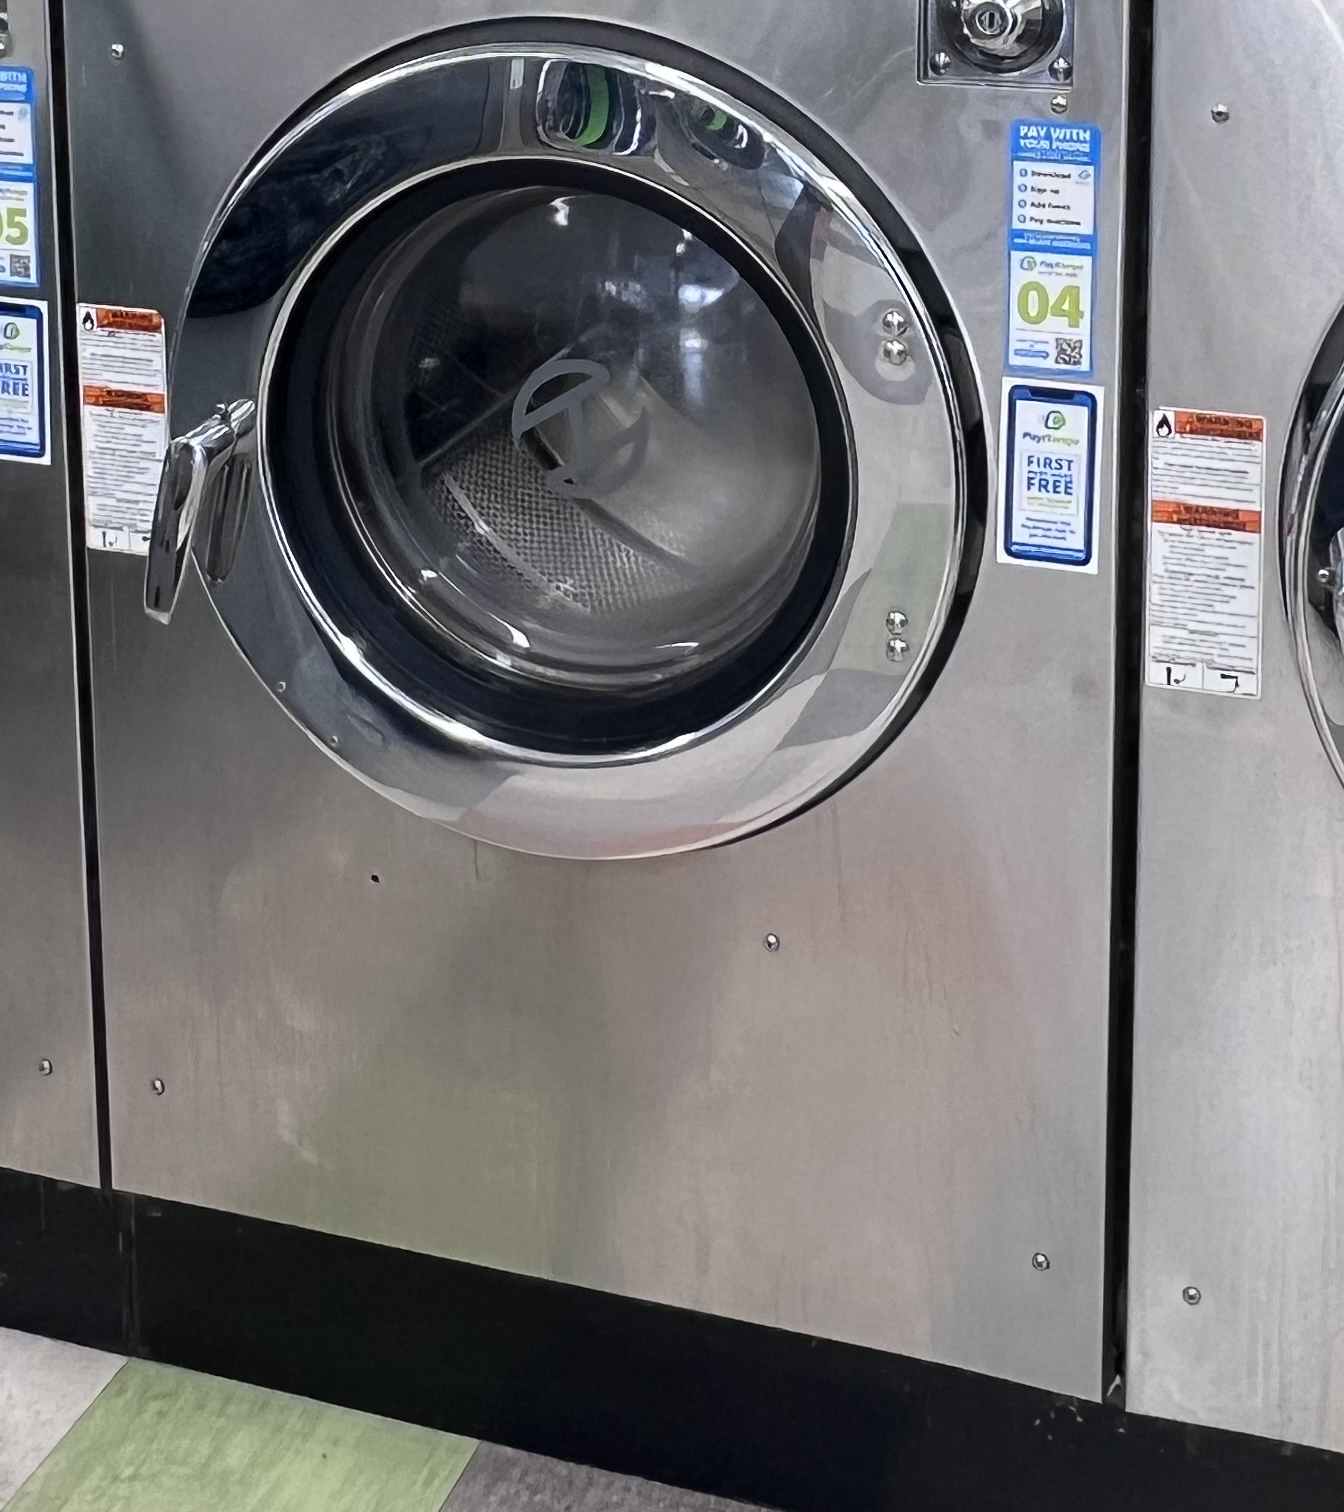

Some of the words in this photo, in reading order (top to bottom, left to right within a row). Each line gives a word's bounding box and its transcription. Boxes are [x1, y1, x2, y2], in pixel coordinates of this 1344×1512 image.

[1019, 125, 1047, 138] PAY
[1050, 126, 1091, 142] WITH
[1017, 281, 1085, 329] 04
[1027, 455, 1074, 472] FIRST
[1027, 476, 1074, 496] FREE
